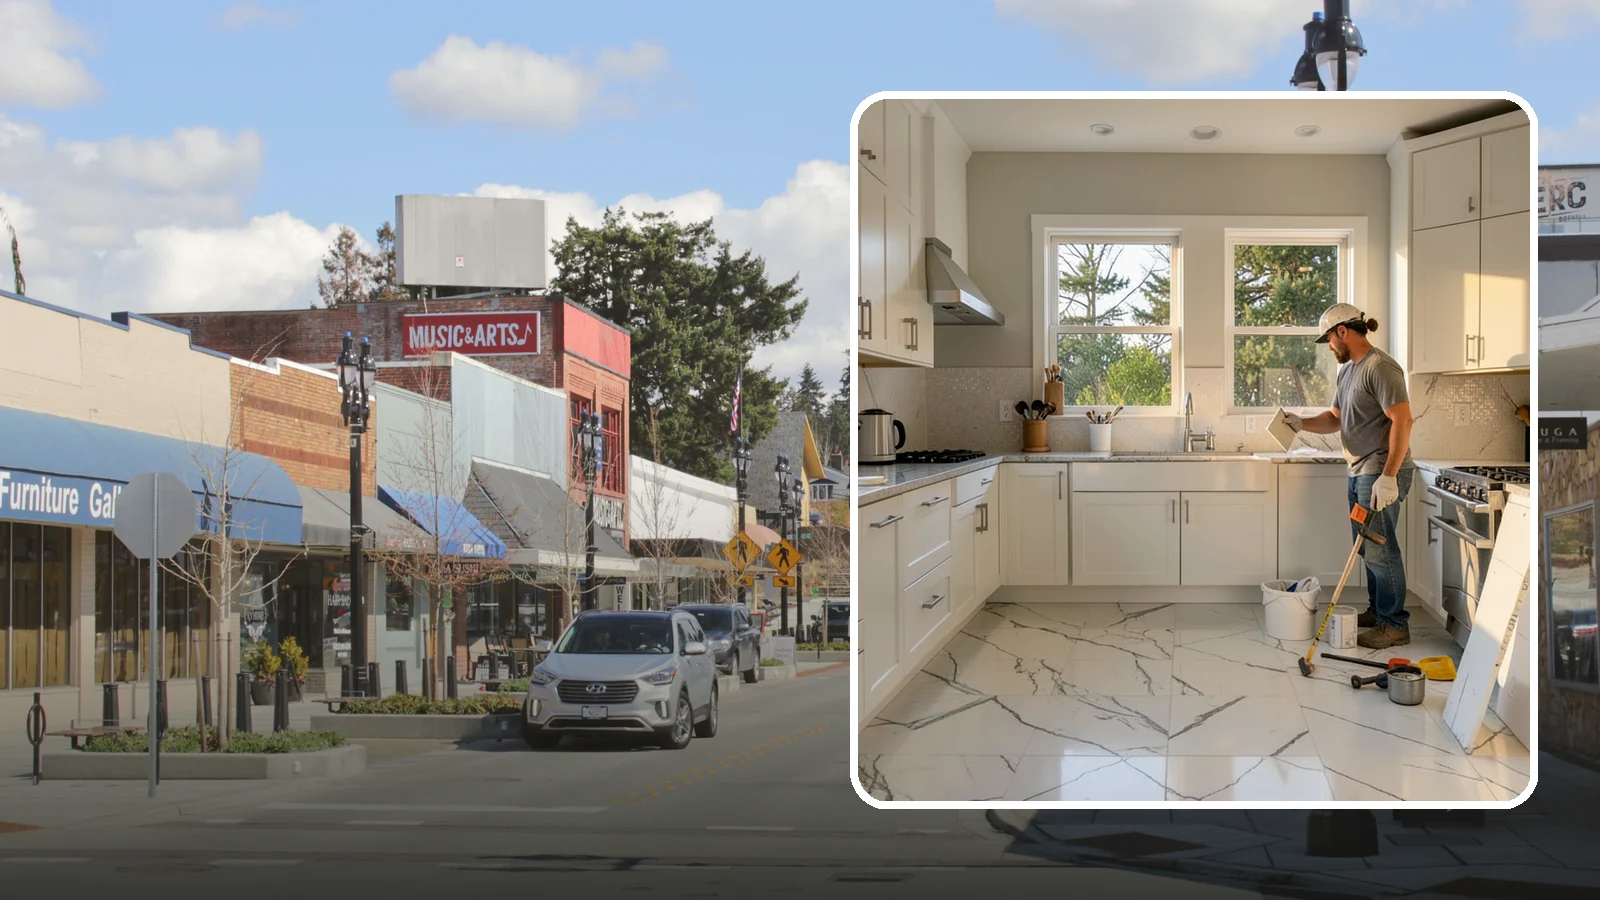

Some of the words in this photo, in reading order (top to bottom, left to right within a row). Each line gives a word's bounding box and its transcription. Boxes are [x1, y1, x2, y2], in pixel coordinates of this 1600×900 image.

[408, 322, 520, 349] MUSIC&ARTS
[1540, 427, 1578, 437] UGA
[0, 472, 79, 515] Furniture
[453, 563, 480, 574] SUSHI
